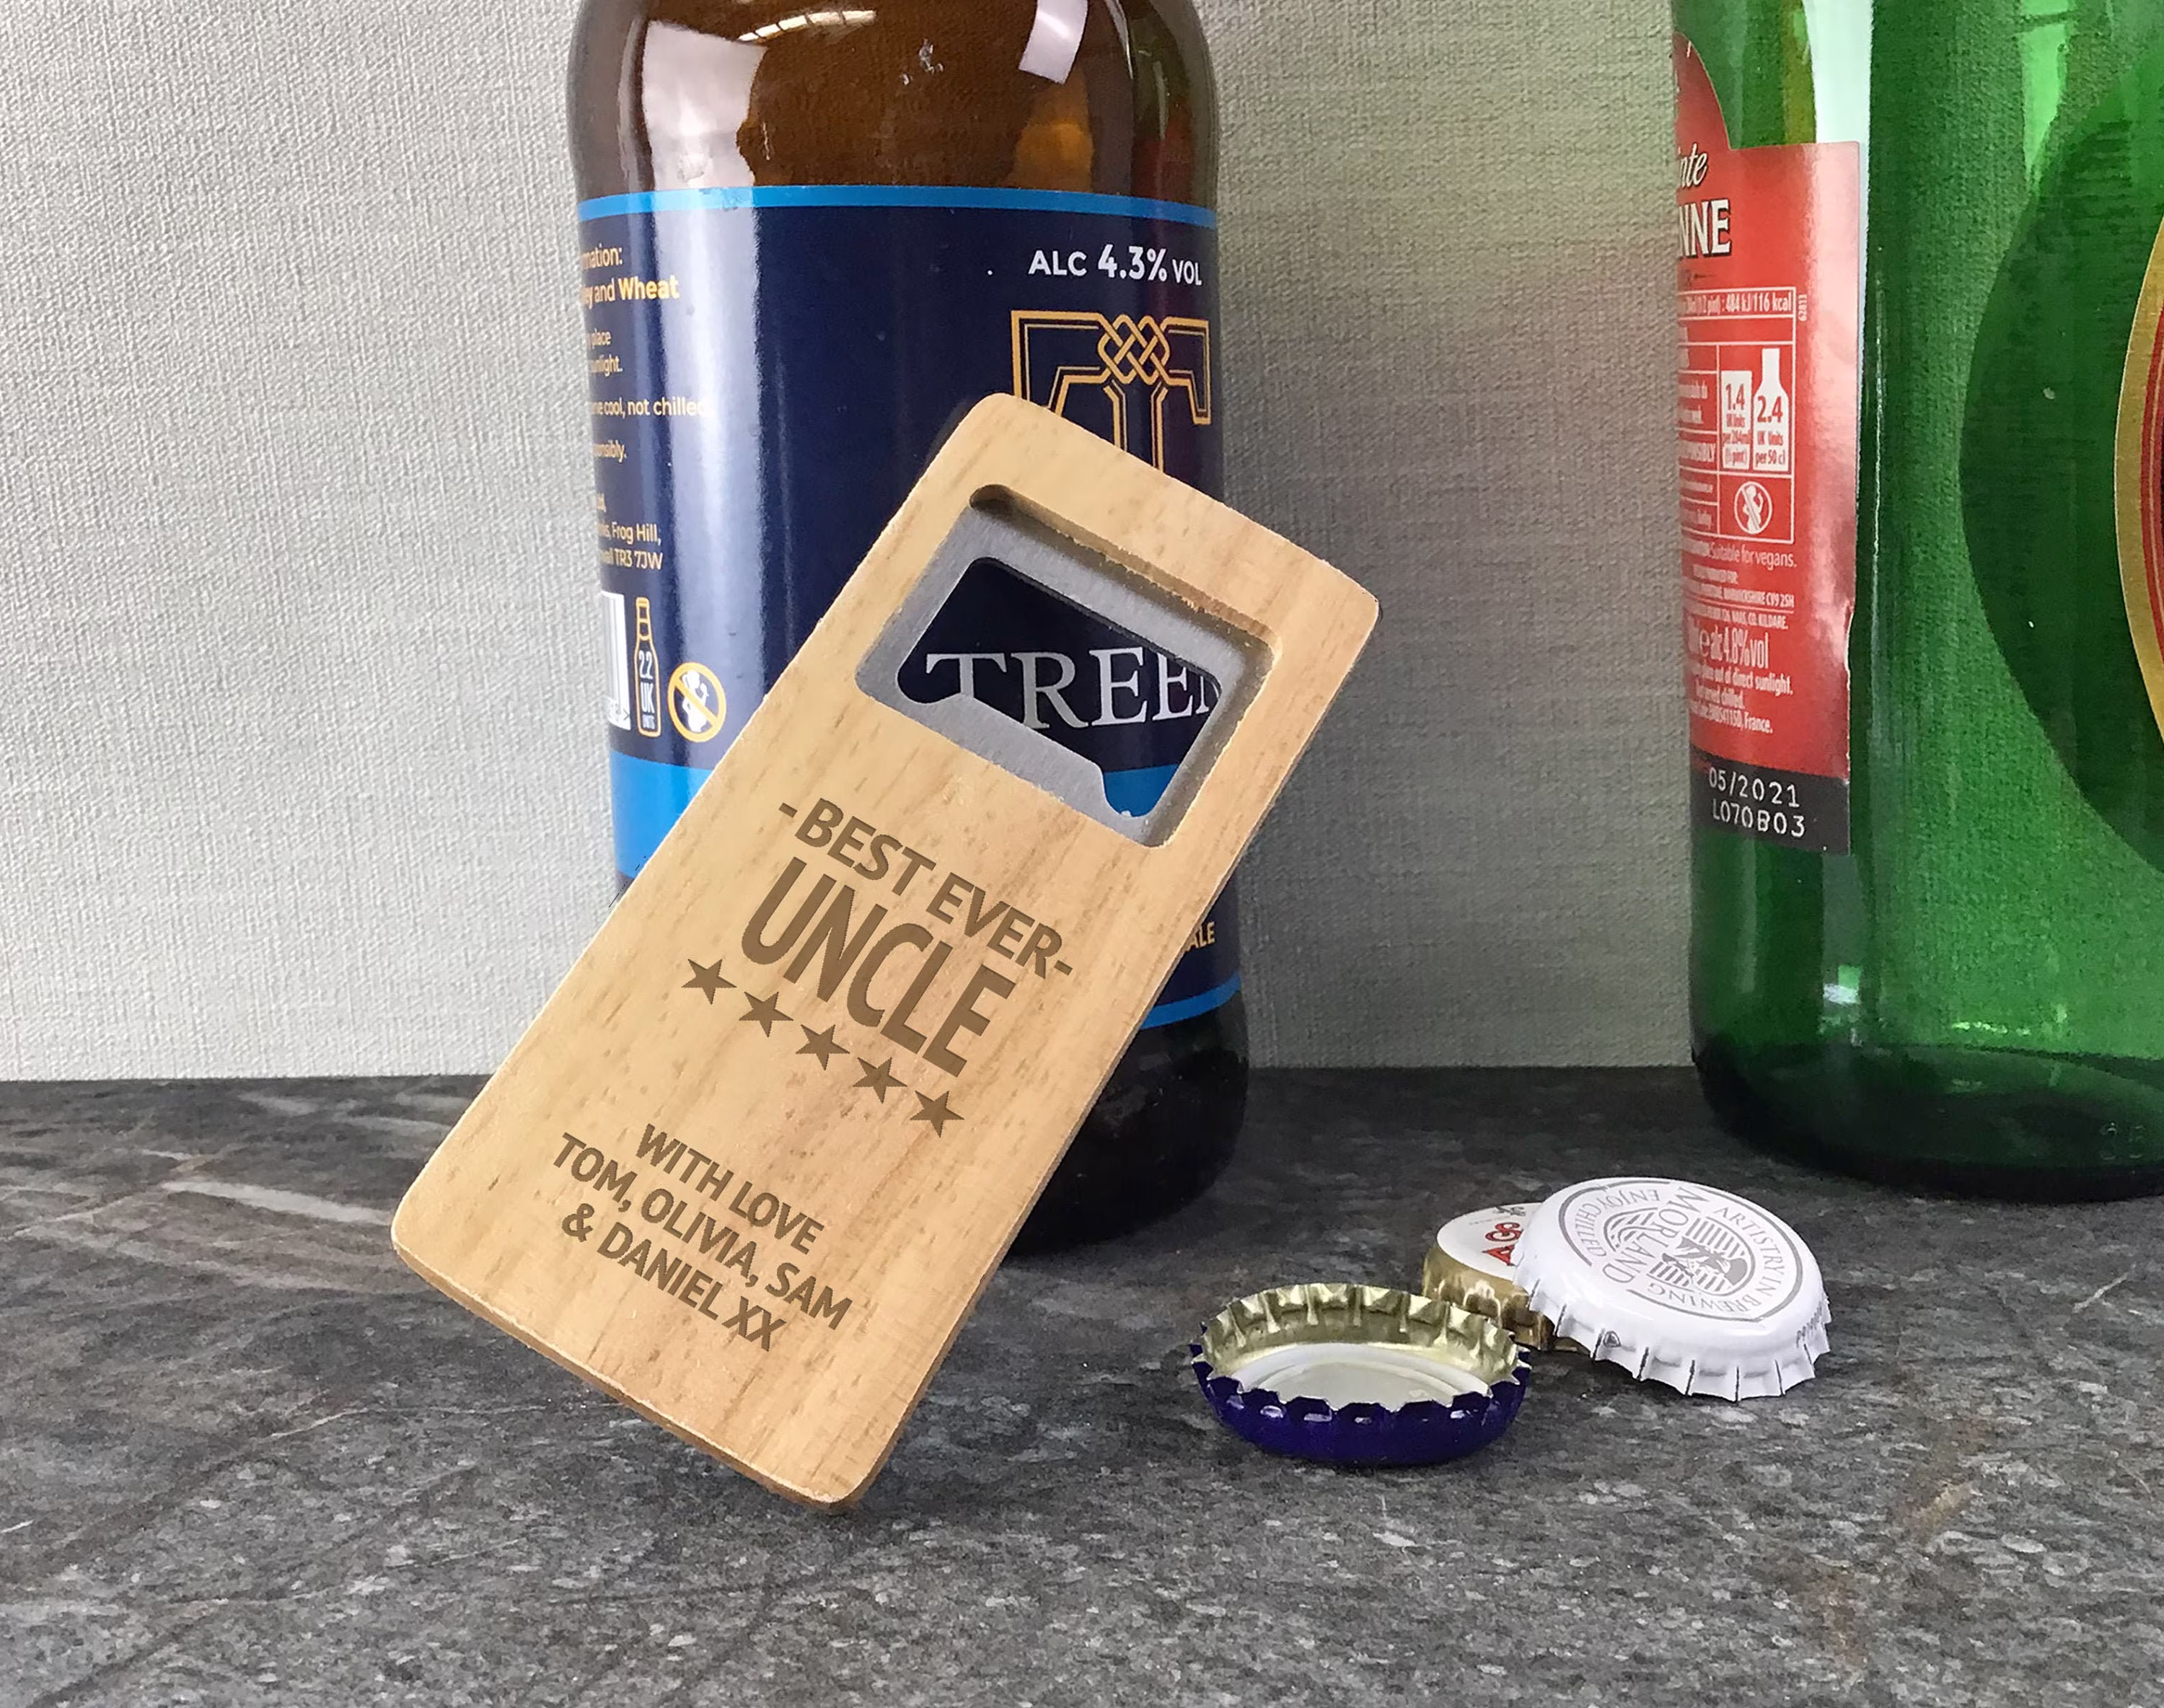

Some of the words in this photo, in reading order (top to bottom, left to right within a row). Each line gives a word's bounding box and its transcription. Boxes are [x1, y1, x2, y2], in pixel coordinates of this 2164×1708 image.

[1028, 250, 1087, 276] ALC
[1098, 244, 1168, 281] 4.3%
[1172, 258, 1202, 286] VOL
[594, 278, 615, 302] and
[617, 275, 679, 300] Wheat
[1772, 291, 1792, 311] kcal
[604, 397, 625, 419] cool,
[628, 399, 651, 416] not
[1725, 384, 1746, 411] 1.4
[1756, 395, 1783, 423] 2.4
[1756, 452, 1767, 467] per
[1768, 449, 1777, 465] 50
[612, 521, 633, 545] Frog
[635, 523, 661, 546] Hill,
[614, 548, 633, 568] TR3
[634, 551, 663, 570] 7JW
[1741, 544, 1754, 563] for
[1755, 552, 1797, 571] vegans.
[641, 682, 655, 713] UK
[1755, 672, 1793, 697] sunlight.
[1744, 711, 1773, 733] France.
[1709, 767, 1800, 808] 05/2021
[1713, 798, 1805, 837] L070B03
[741, 856, 1016, 1078] UNCLE
[635, 1123, 734, 1202] WITH
[729, 1181, 824, 1255] LOVE
[1596, 1189, 1661, 1210] ENJOY
[553, 1132, 638, 1212] TOM,
[641, 1188, 759, 1287] OLIVIA,
[765, 1262, 853, 1331] SAM
[1575, 1202, 1607, 1258] CHILLED
[1601, 1187, 1710, 1284] MORLAND
[1715, 1206, 1786, 1277] ARTISTRY
[561, 1203, 595, 1242] &
[597, 1222, 723, 1321] DANIEL
[721, 1295, 787, 1352] XX
[1647, 1282, 1762, 1313] BREWING
